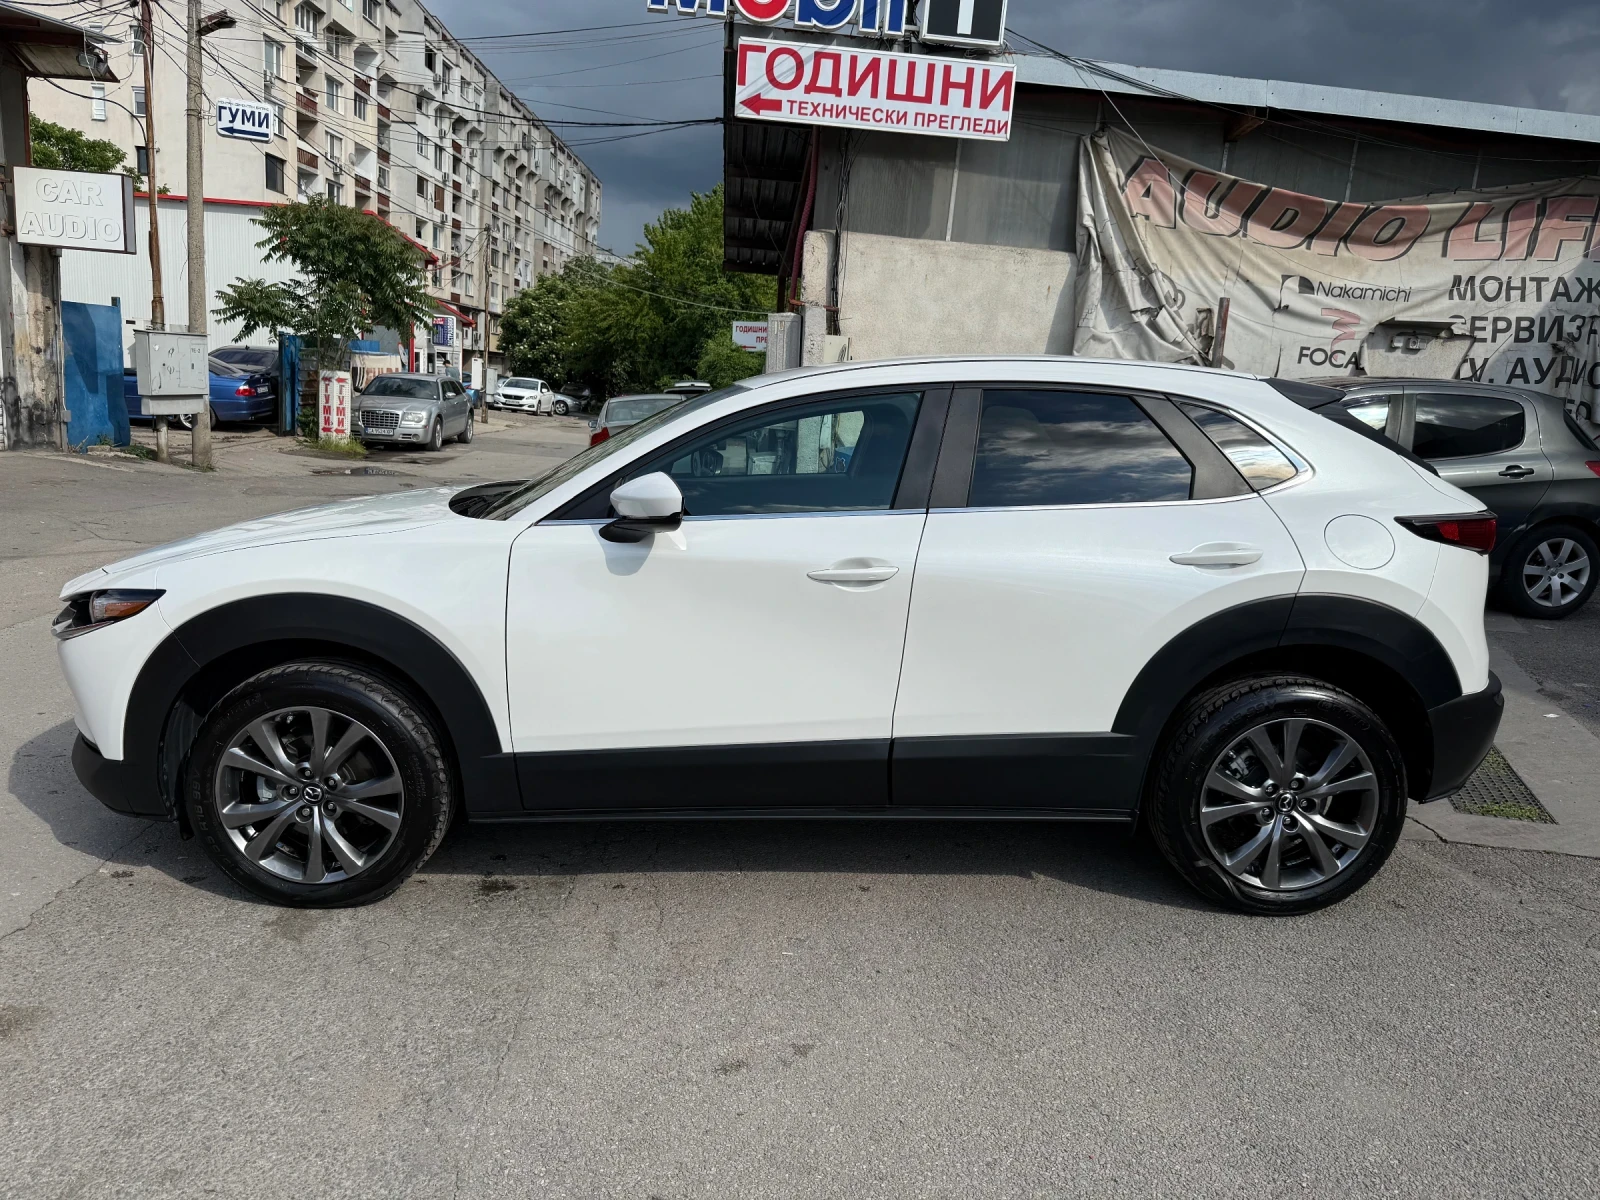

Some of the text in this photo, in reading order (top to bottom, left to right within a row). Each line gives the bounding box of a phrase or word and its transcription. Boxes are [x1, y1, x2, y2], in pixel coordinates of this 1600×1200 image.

[737, 43, 1013, 112] ГОДИШНИ
[218, 105, 269, 129] ГУМИ
[786, 100, 1009, 135] ТЕХНИЧЕСКИ ПРЕГЛЕДИ
[36, 178, 103, 206] CAR
[1122, 155, 1600, 262] AUDIO LIF
[20, 211, 121, 242] AUDIO
[1316, 281, 1412, 302] Nakamichi
[1449, 275, 1600, 303] МОНТАЖ
[323, 383, 332, 426] ГУМИ
[336, 385, 346, 427] ГУМИ
